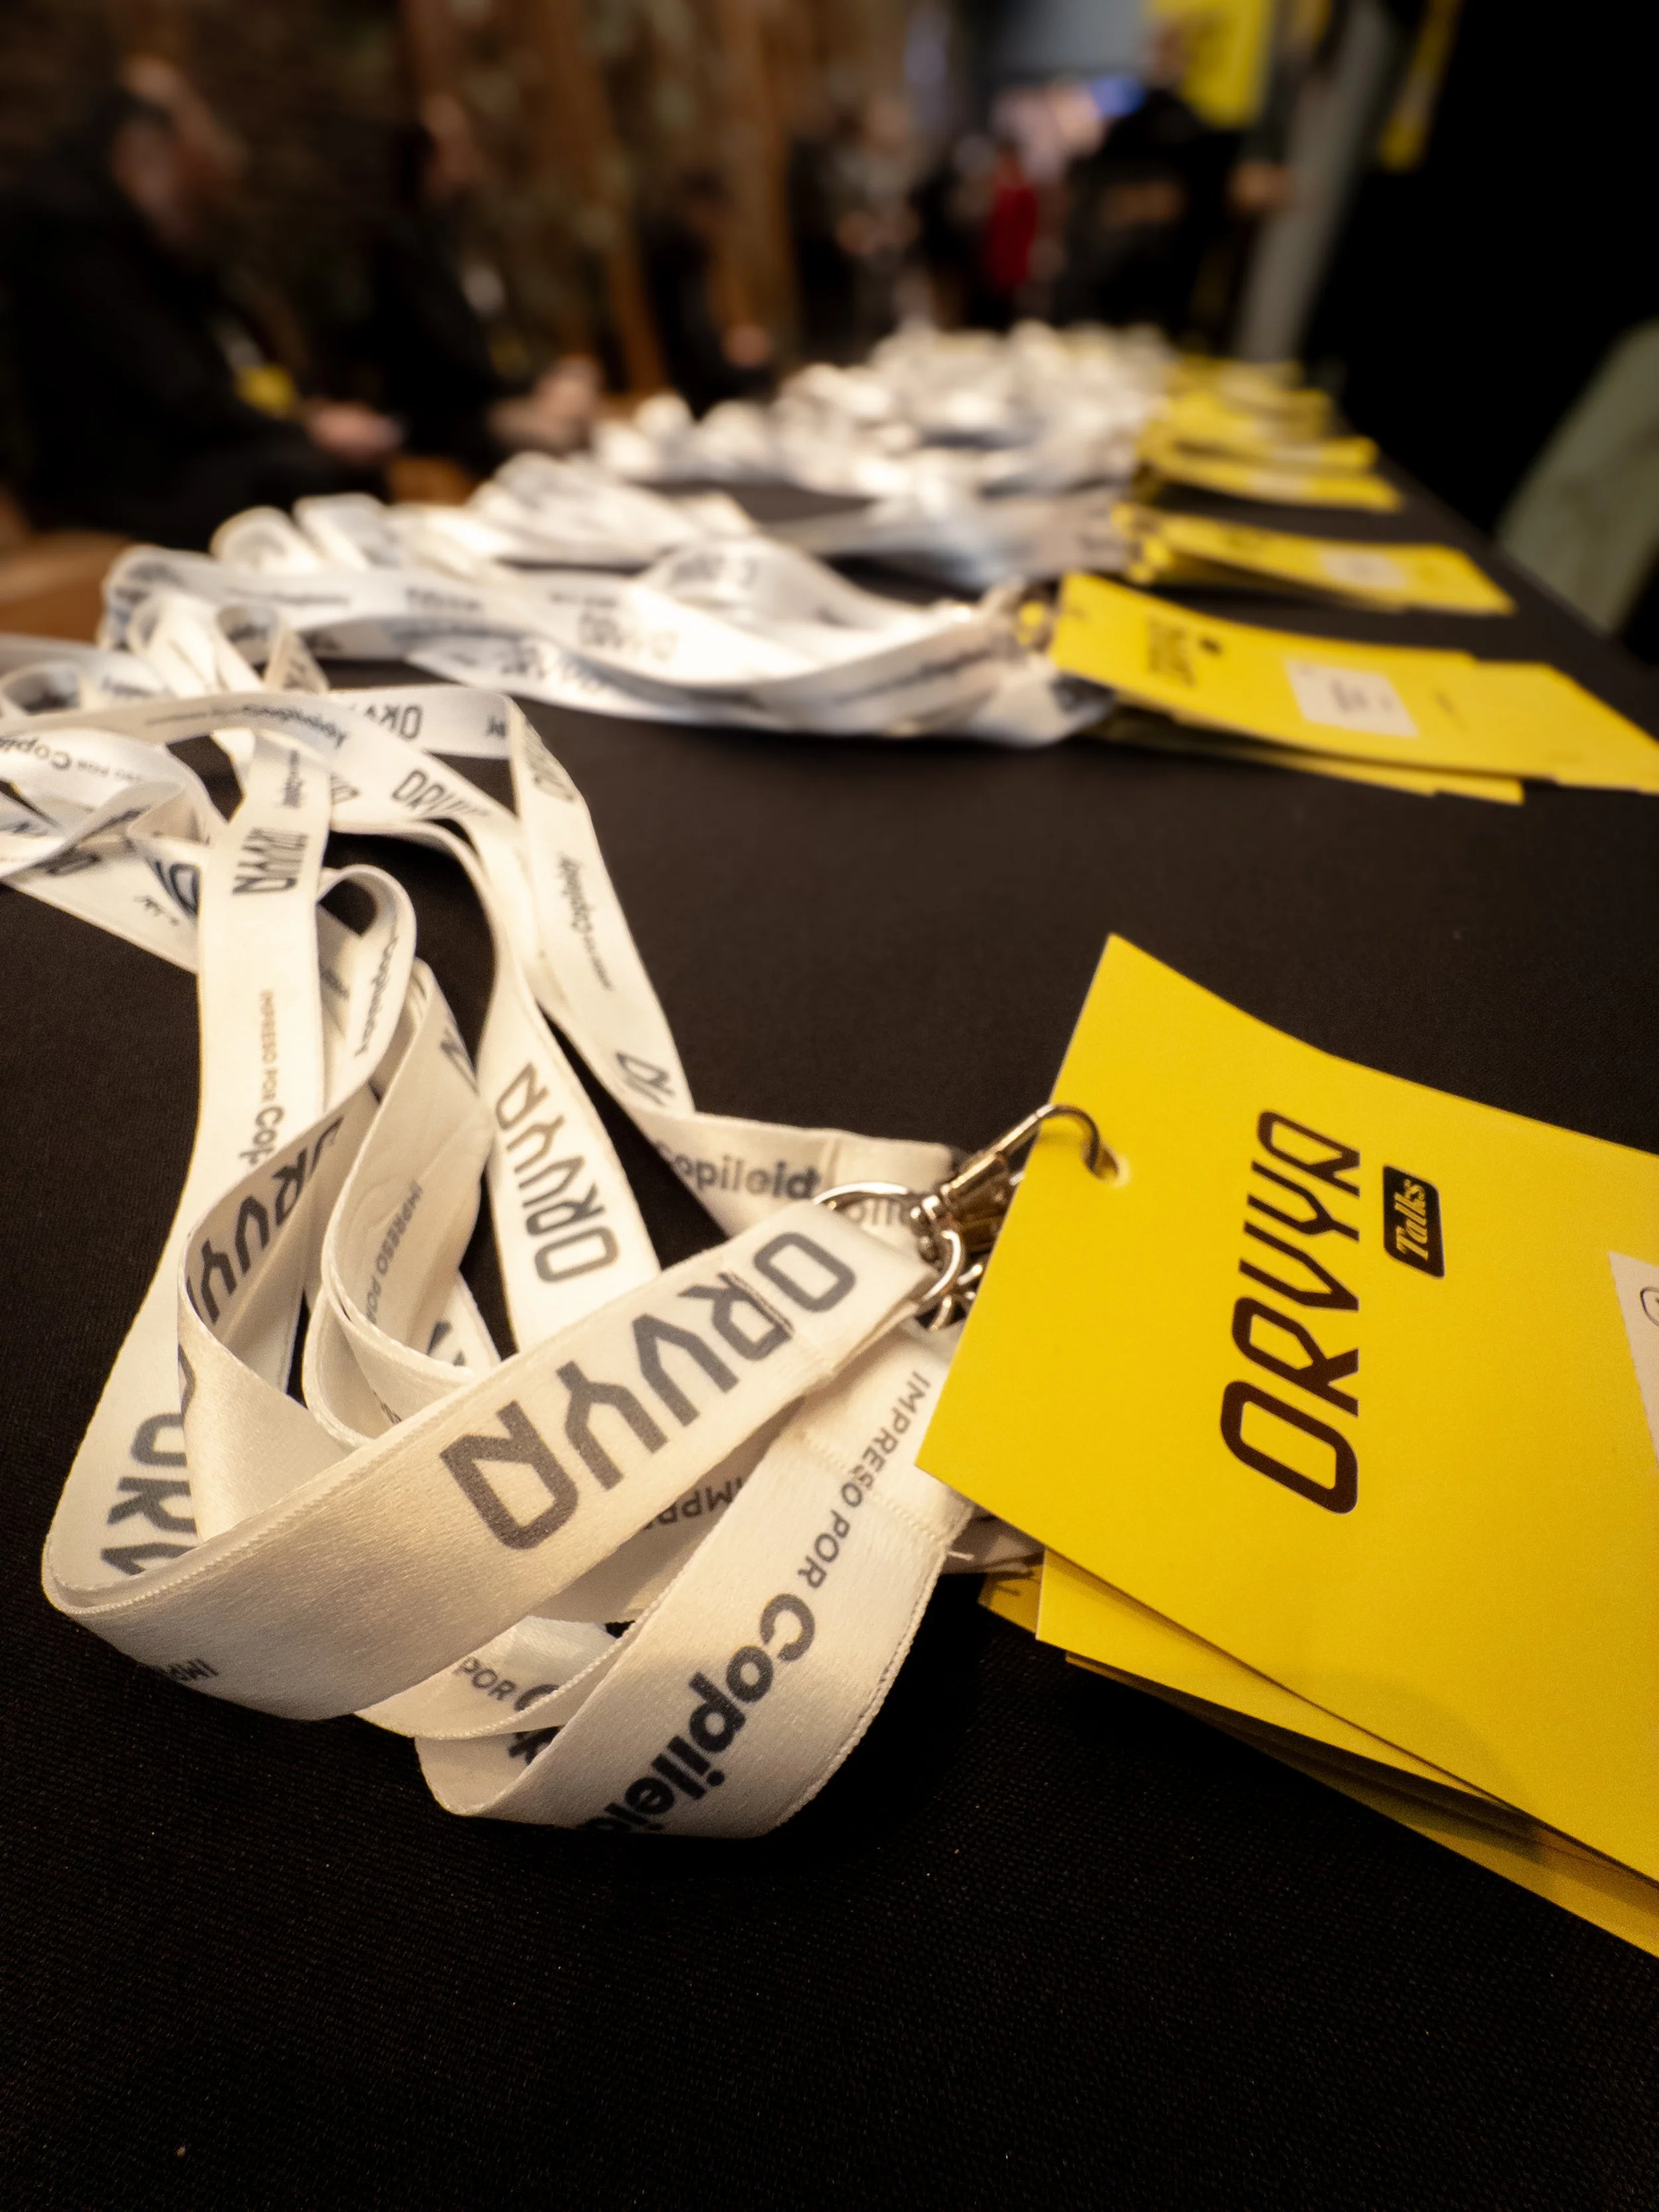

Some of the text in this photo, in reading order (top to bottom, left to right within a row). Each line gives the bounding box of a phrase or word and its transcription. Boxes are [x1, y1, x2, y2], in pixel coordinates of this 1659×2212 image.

[495, 1062, 620, 1284] ORVYN
[1220, 1110, 1360, 1514] ORVYN
[1393, 1178, 1429, 1262] Talks
[439, 1231, 857, 1551] ORVYN
[583, 1370, 931, 1833] IMPRESO POR Copilei
